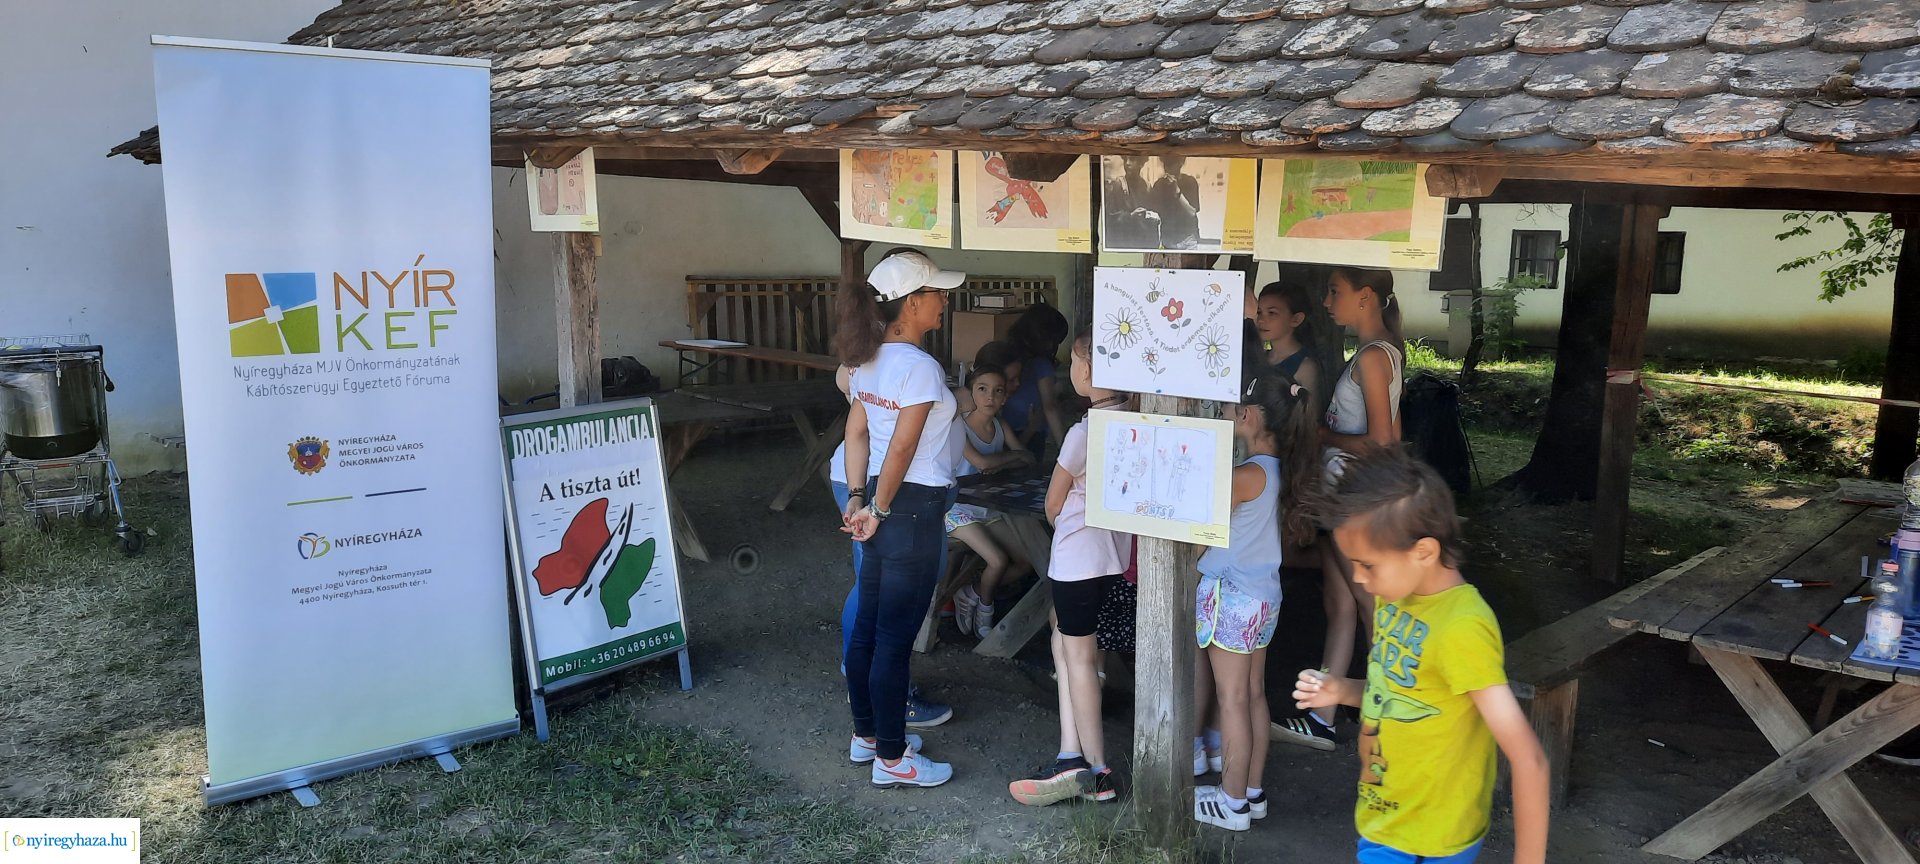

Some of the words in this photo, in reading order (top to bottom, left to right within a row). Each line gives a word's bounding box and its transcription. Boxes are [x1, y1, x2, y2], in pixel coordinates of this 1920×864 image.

[333, 254, 457, 311] NYÍR
[335, 310, 458, 352] KEF
[233, 362, 313, 382] Nyíregyháza
[316, 360, 342, 375] MJV
[345, 353, 461, 373] Önkormányzatának
[246, 380, 340, 397] Kábítószerügyi
[405, 374, 450, 387] Fóruma
[338, 434, 397, 446] NYÍREGYHÁZA
[338, 447, 371, 457] MEGYEI
[396, 441, 424, 451] VÁROS
[511, 413, 652, 460] DROGAMBULANCIA
[540, 482, 555, 502] A
[560, 475, 612, 499] tiszta
[617, 467, 641, 489] út!
[334, 527, 423, 549] NYÍREGYHÁZA
[338, 564, 388, 578] Nyíregyháza
[291, 584, 323, 596] Megyei
[345, 576, 369, 586] Város
[299, 596, 320, 606] 4400
[376, 581, 408, 593] Kossuth
[409, 579, 422, 587] tér
[545, 658, 587, 678] Mobil:
[590, 650, 611, 664] +36
[613, 646, 625, 659] 20
[627, 640, 646, 653] 489
[648, 635, 661, 647] 66
[662, 630, 675, 642] 94
